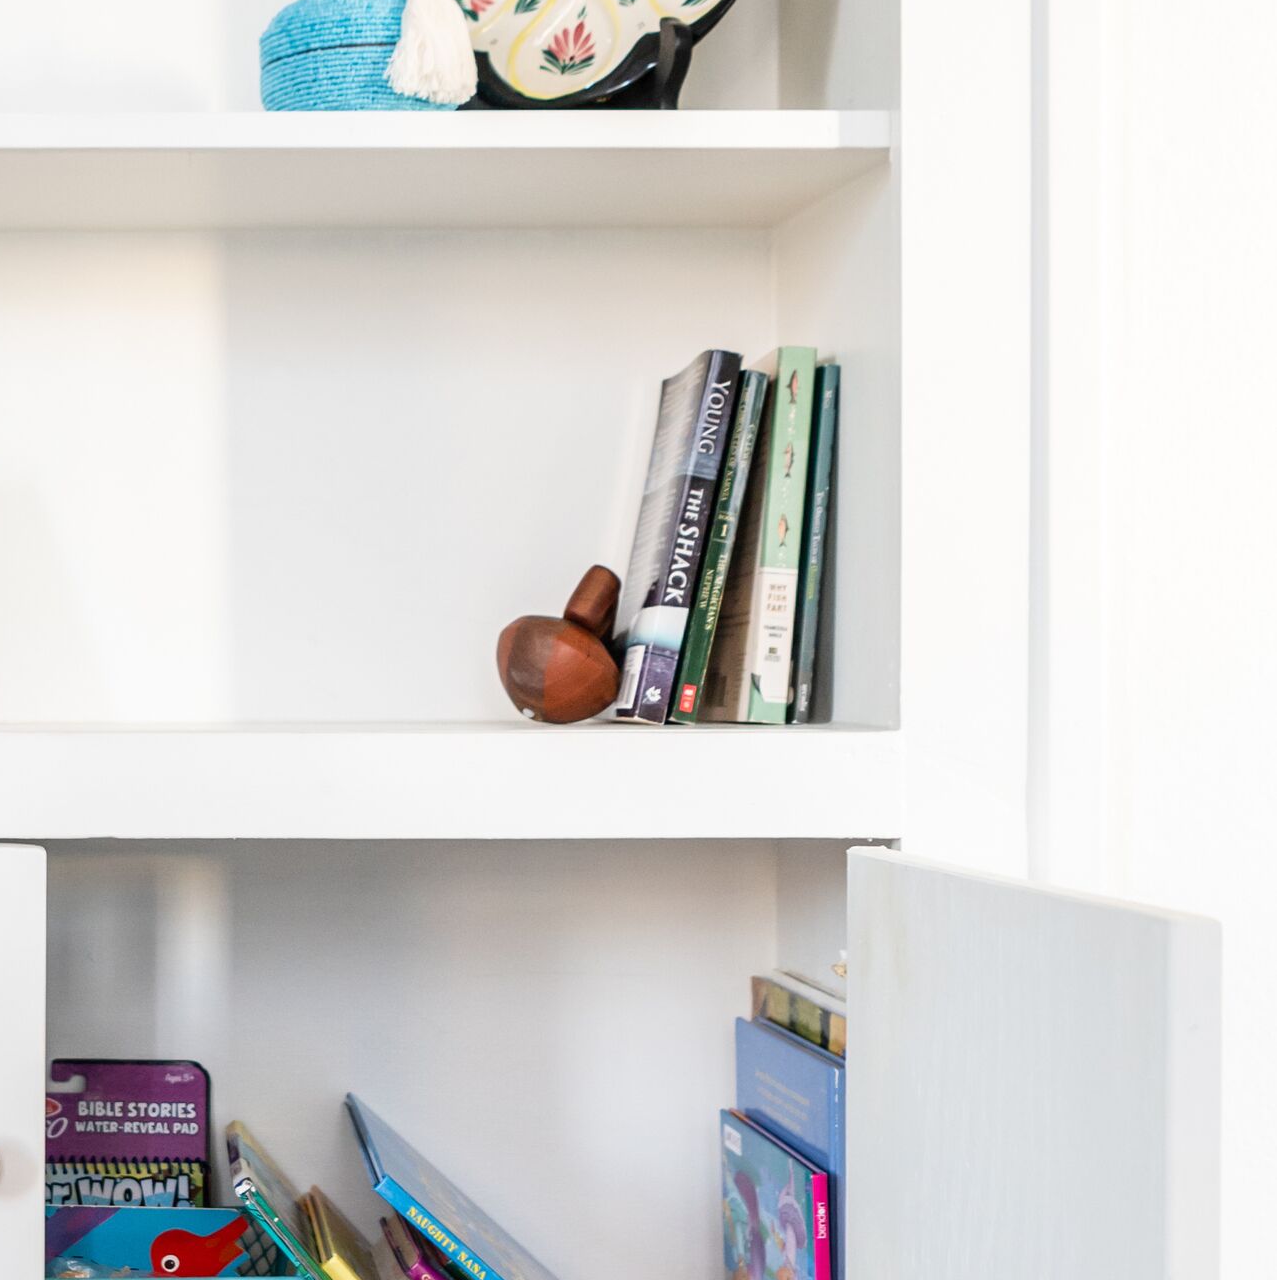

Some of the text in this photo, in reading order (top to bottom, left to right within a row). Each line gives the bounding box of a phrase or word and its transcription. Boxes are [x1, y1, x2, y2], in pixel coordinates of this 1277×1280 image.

[699, 380, 731, 454] YOUNG
[721, 470, 734, 501] NARNIA
[664, 488, 704, 604] THE SHACK
[720, 524, 728, 537] 1
[699, 569, 715, 609] NEPHEW
[705, 553, 728, 631] THE MAGICIAN'S
[766, 604, 788, 612] FART
[165, 1073, 182, 1084] Ages
[77, 1101, 123, 1117] BIBLE
[127, 1102, 196, 1118] STORIES
[75, 1121, 199, 1135] WATER-REVEAL PAD
[76, 1173, 191, 1207] WOW!
[816, 1202, 827, 1239] bendon
[406, 1206, 486, 1280] NAUGHTY NANA
